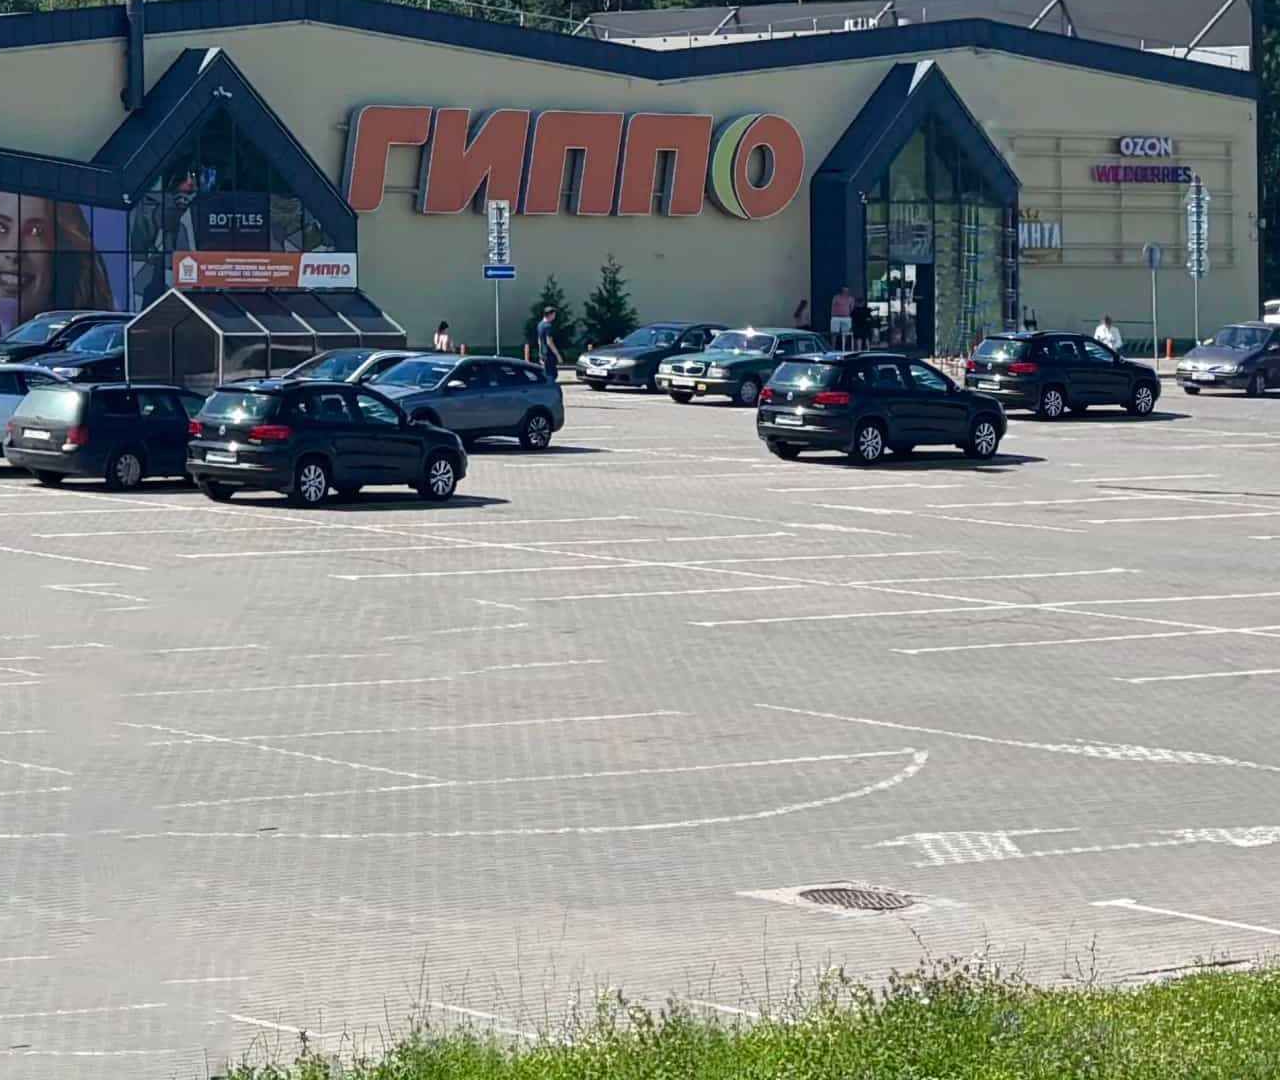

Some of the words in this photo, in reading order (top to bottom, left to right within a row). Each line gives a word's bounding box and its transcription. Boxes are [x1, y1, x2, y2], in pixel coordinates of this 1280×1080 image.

[1120, 137, 1172, 156] OZON
[345, 103, 806, 220] ГИППО
[209, 213, 263, 230] BOTTLES
[1020, 223, 1061, 248] ИНТА
[302, 263, 351, 276] ГИППО
